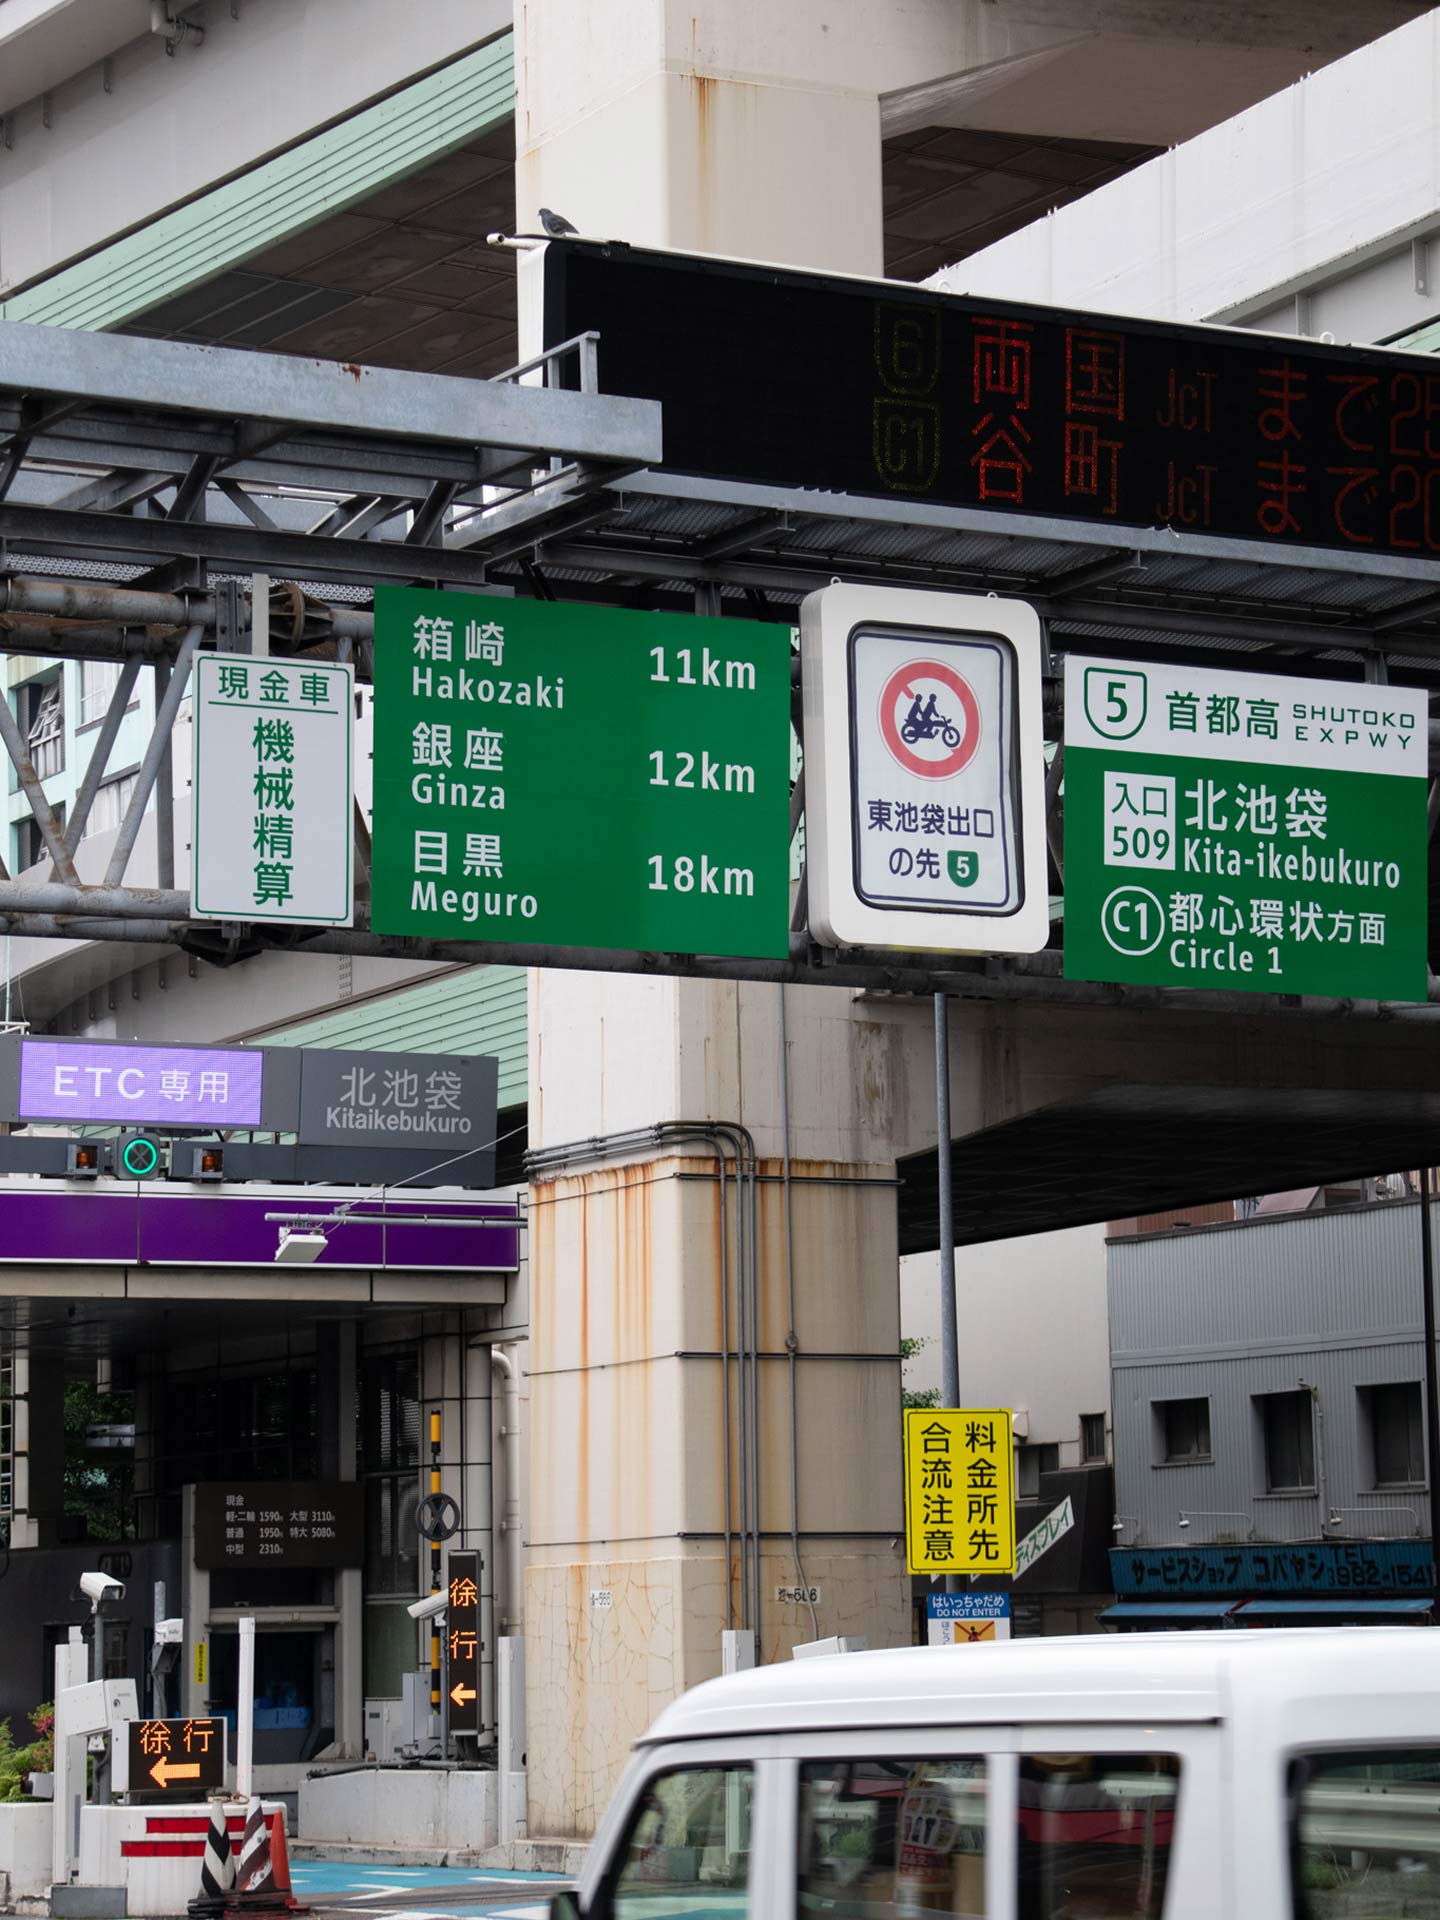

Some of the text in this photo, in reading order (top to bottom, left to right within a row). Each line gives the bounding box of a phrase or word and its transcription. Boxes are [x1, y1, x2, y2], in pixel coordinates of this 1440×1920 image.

[413, 614, 506, 667] 箱崎
[218, 664, 331, 707] 現金車
[412, 666, 566, 710] Hakozaki
[649, 646, 757, 690] 11km
[1107, 682, 1128, 723] 5
[1165, 689, 1281, 741] 首都高
[1292, 703, 1416, 730] SHUTOKO
[412, 721, 505, 772] 銀座
[1296, 726, 1412, 751] EXPWY
[411, 773, 506, 810] Ginza
[648, 749, 756, 794] 12km
[252, 716, 295, 908] 機械精算
[866, 798, 995, 840] 東池袋出口
[1111, 781, 1169, 819] 入口
[1184, 778, 1328, 842] 北池袋
[414, 830, 504, 879] 目黒
[888, 847, 972, 880] の先 5
[1112, 826, 1170, 862] 509
[1184, 837, 1400, 889] Kita-ikebukuro
[647, 854, 755, 897] 18km
[411, 880, 538, 922] Meguro
[1112, 902, 1149, 941] C1
[1169, 892, 1386, 947] 都心環状方面
[1170, 938, 1283, 975] Circle 1
[54, 1065, 230, 1104] ETC 専用
[340, 1066, 463, 1112] 北池袋
[326, 1105, 472, 1135] Kitaikebukuro
[921, 1422, 955, 1560] 合流注意
[965, 1421, 999, 1561] 料金所先
[1131, 1553, 1325, 1585] サービスショップ コバヤシ
[1329, 1544, 1376, 1565] TEL
[450, 1577, 478, 1659] 徐行
[933, 1595, 1004, 1608] はいっちゃだめ
[972, 1608, 1000, 1616] ENTER
[140, 1719, 214, 1754] 徐行
